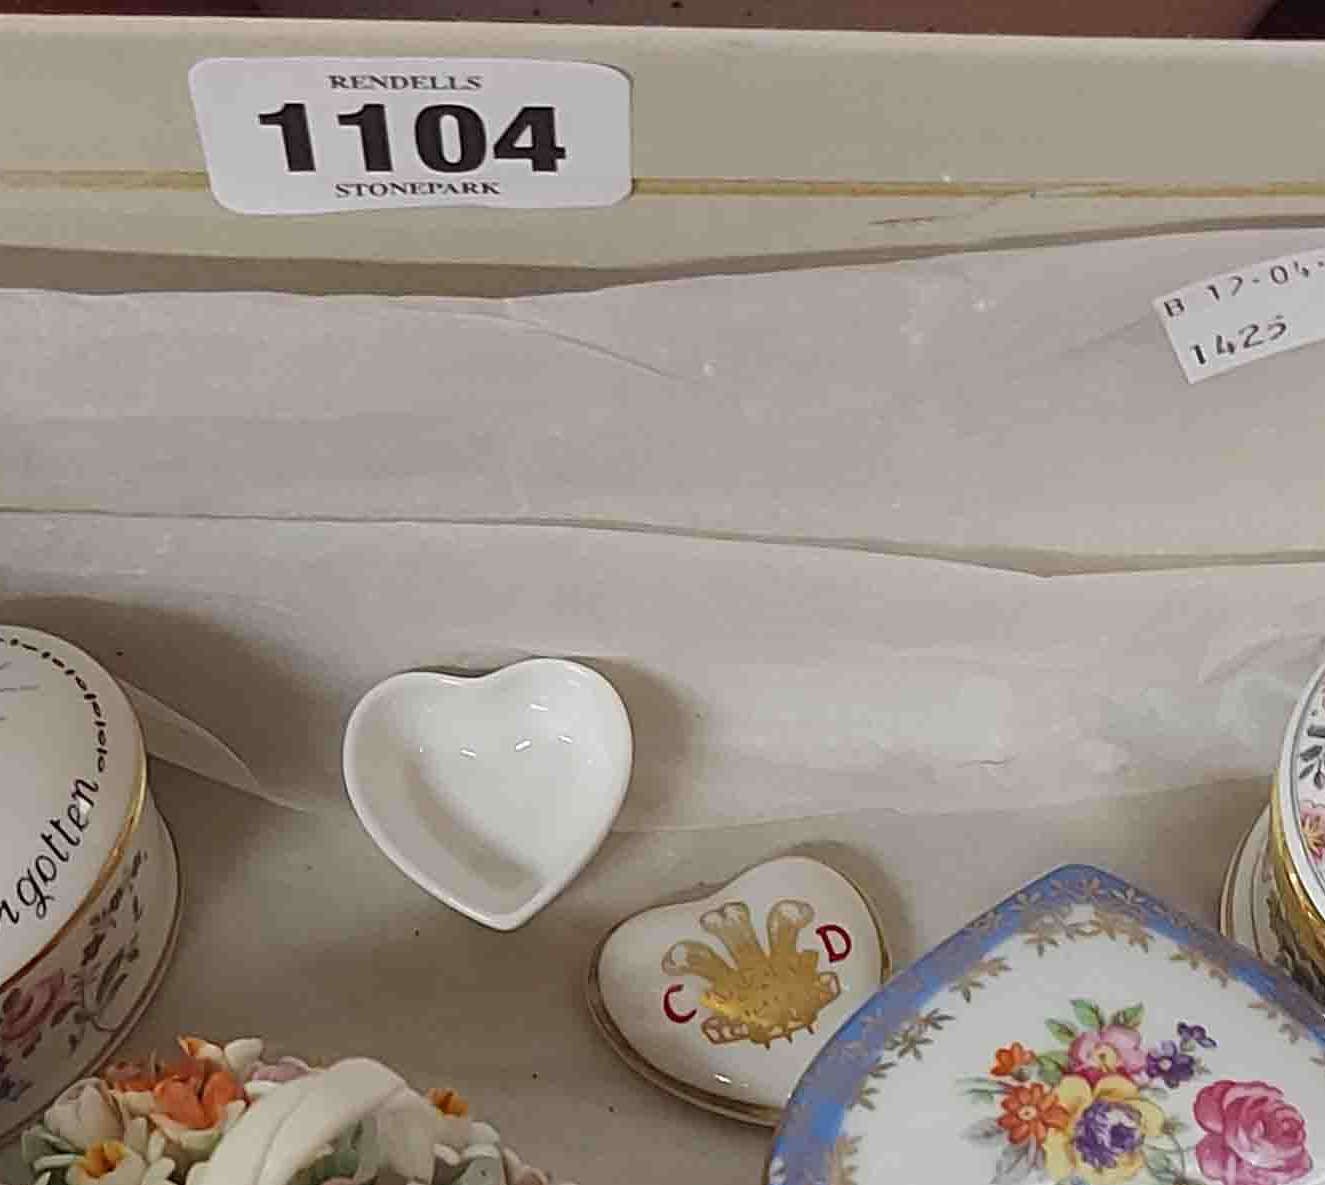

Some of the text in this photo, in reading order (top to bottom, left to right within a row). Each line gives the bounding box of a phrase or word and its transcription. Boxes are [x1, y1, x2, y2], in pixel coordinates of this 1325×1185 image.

[329, 75, 482, 90] RENDELLS
[258, 102, 566, 173] 1104
[335, 181, 501, 197] STONEPARK
[815, 924, 852, 963] D
[662, 983, 698, 1024] C
